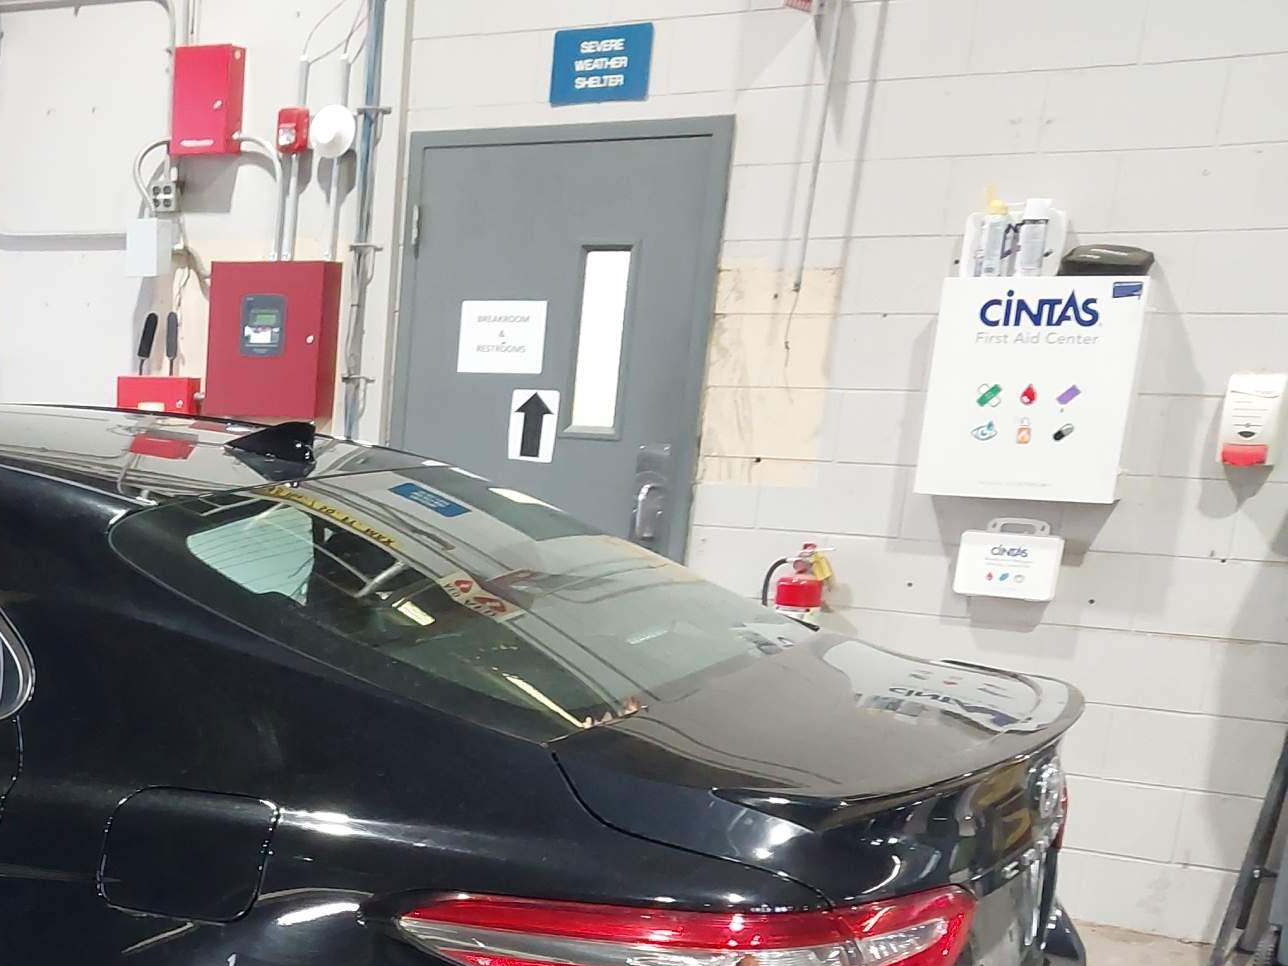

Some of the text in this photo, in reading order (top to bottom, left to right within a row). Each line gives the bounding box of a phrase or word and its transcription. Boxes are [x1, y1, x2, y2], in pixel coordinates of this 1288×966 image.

[580, 38, 626, 53] SEVERE
[574, 56, 629, 72] WEATHER
[574, 74, 625, 89] SHELTER
[477, 315, 530, 323] BREAKROOM
[975, 332, 1100, 345] First Aid Center
[476, 345, 527, 353] RESTROOMS
